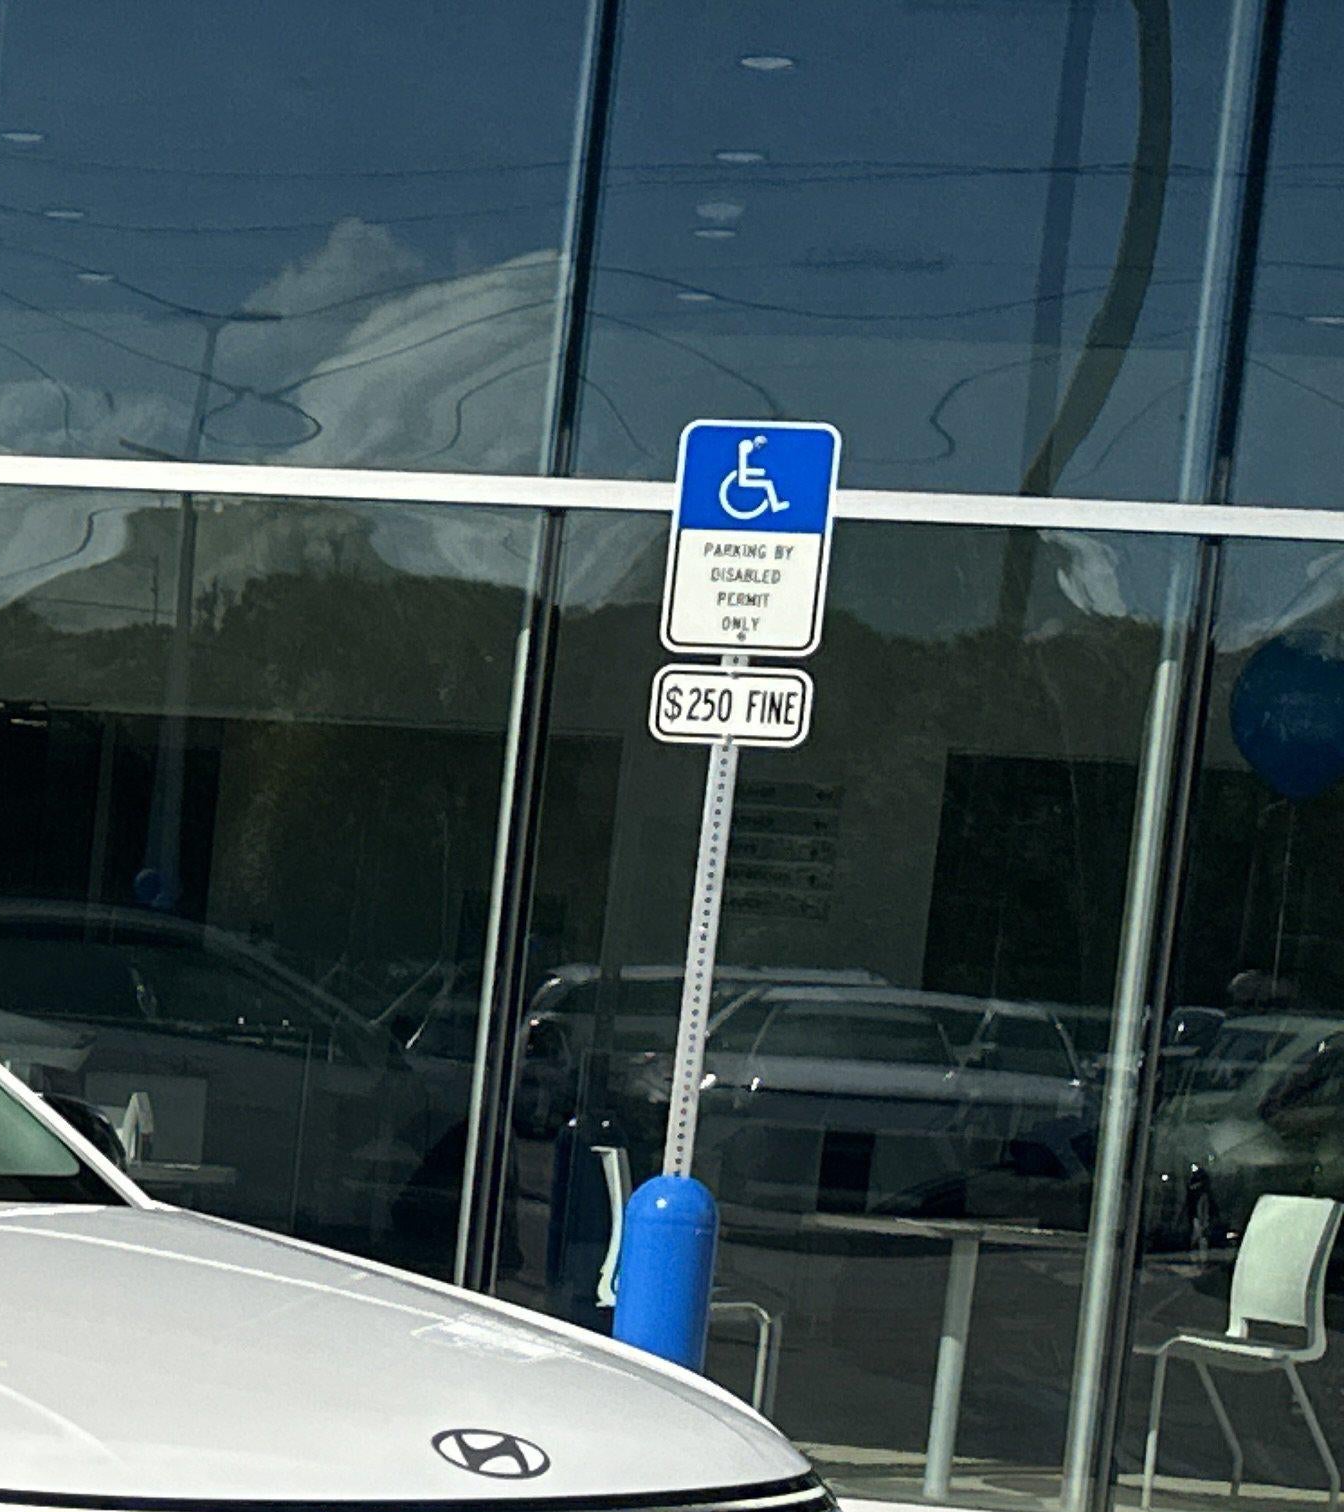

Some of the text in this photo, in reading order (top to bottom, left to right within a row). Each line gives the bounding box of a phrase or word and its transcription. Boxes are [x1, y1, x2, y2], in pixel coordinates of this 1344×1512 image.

[704, 542, 794, 560] PARKING BY
[711, 567, 781, 584] DISABLED
[717, 591, 770, 608] PERMIT
[721, 615, 760, 631] ONLY
[664, 685, 799, 725] $250 FINE
